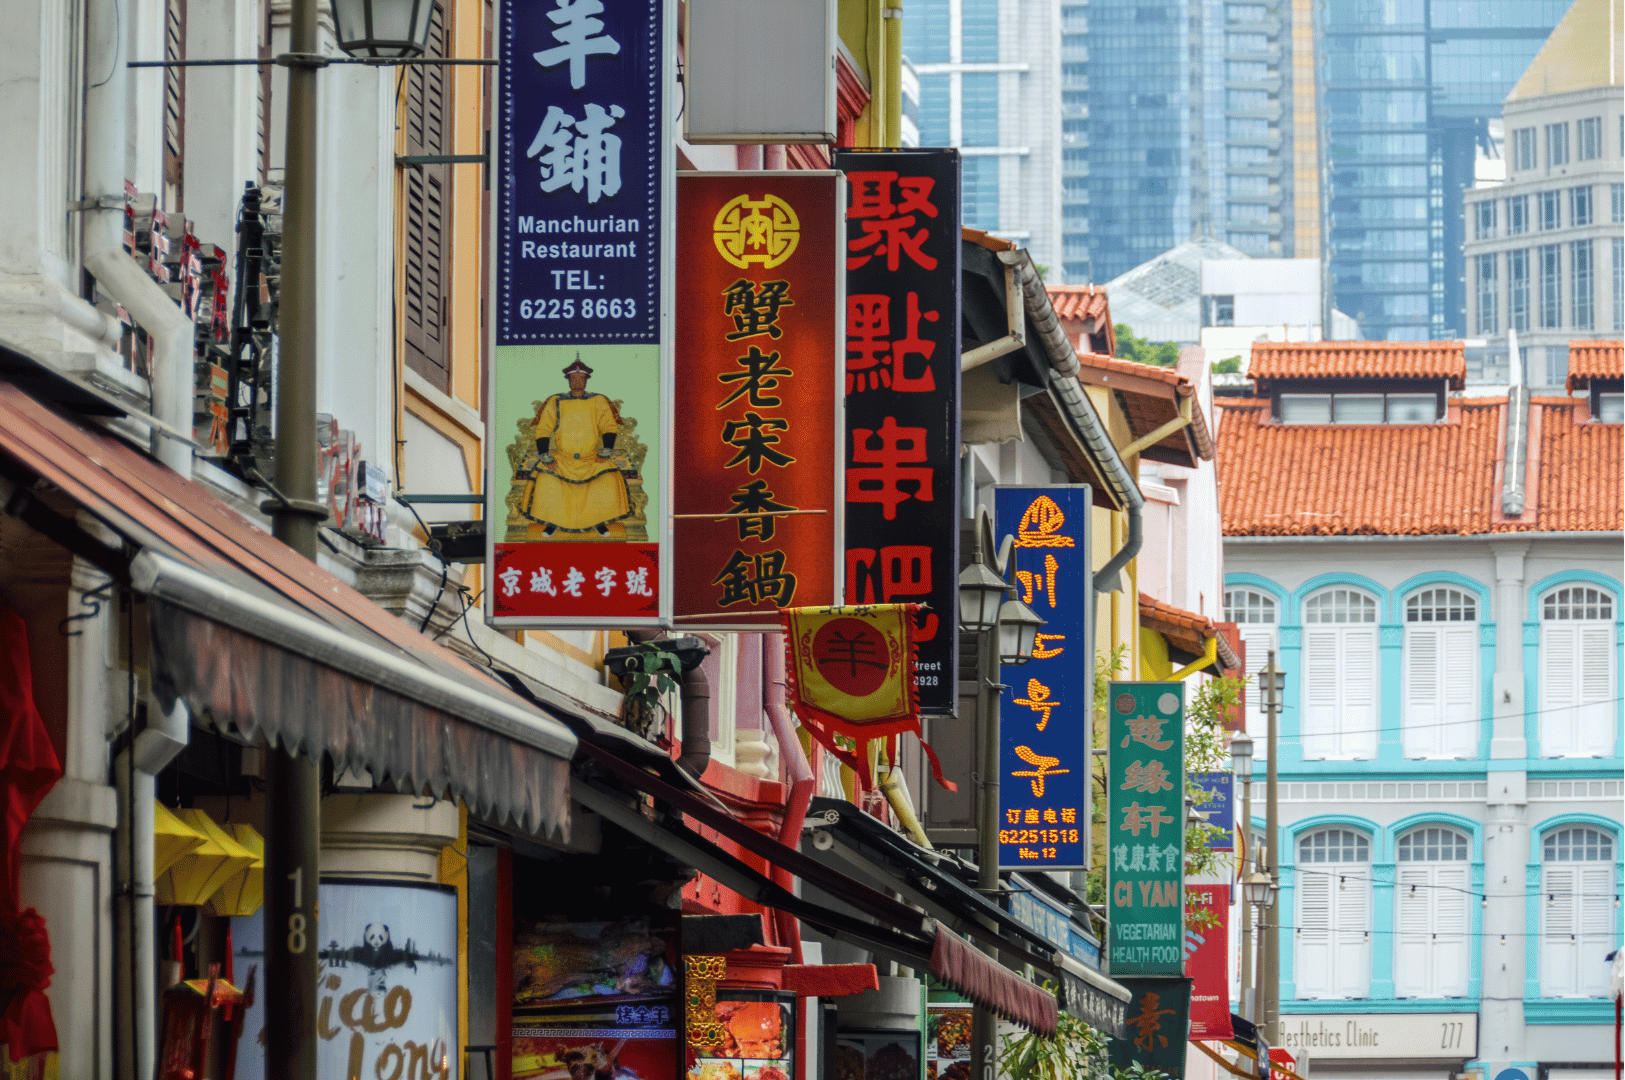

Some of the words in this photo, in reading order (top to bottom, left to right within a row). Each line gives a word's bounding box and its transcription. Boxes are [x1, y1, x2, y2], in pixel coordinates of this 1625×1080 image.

[517, 214, 640, 234] Manchurian
[521, 240, 637, 258] Restaurant
[550, 269, 605, 290] TEL:
[519, 298, 575, 319] 6225
[581, 298, 637, 319] 8663
[711, 278, 798, 608] 蟹老宋香鍋
[499, 566, 654, 598] 京城老字號
[818, 630, 889, 678] 羊
[912, 660, 941, 671] treet
[1006, 808, 1077, 825] 订座电话
[999, 829, 1079, 845] 62251518
[1041, 846, 1057, 859] 12
[1112, 843, 1179, 873] 健康素食
[1114, 881, 1132, 907] CI
[1138, 881, 1178, 907] YAN
[1116, 923, 1176, 940] VEGETARIAN
[1112, 946, 1149, 963] HEALTH
[1152, 946, 1179, 963] FOOD
[316, 960, 412, 1041] iao
[1190, 994, 1220, 1002] natown
[1126, 991, 1176, 1053] 素
[1279, 1021, 1341, 1047] Aesthetics
[1346, 1020, 1379, 1047] Clinic
[1441, 1022, 1463, 1049] 277
